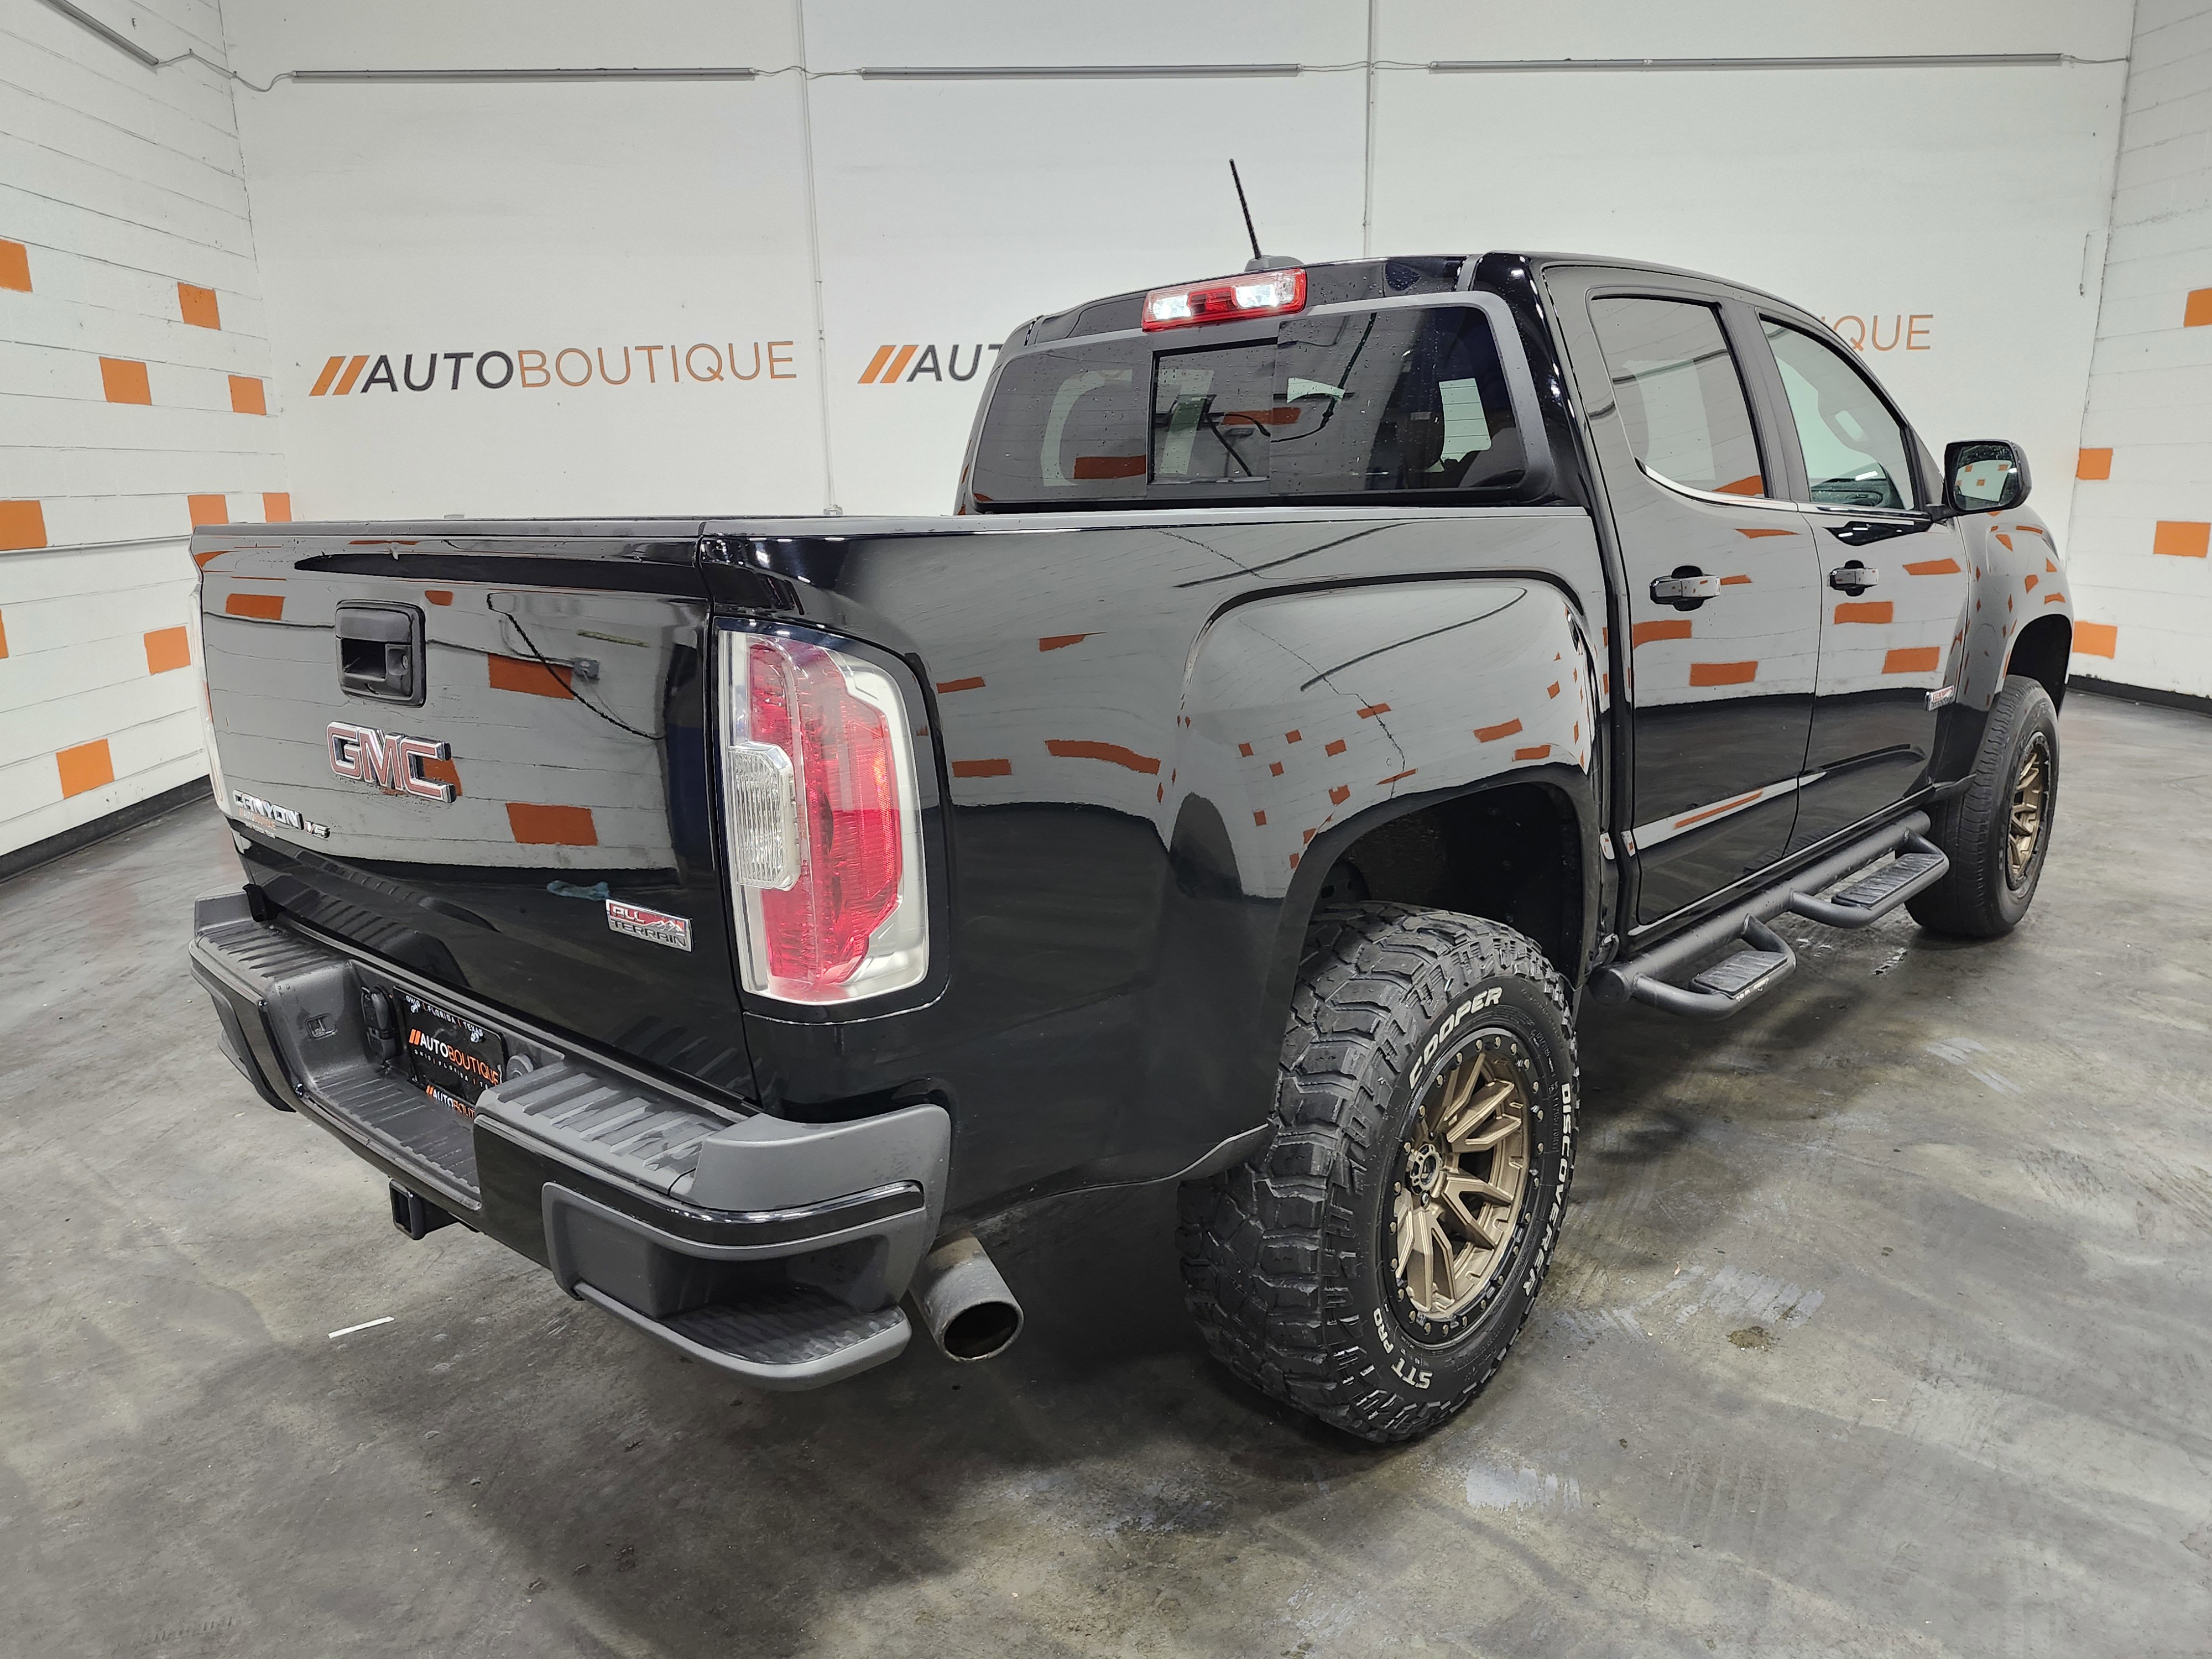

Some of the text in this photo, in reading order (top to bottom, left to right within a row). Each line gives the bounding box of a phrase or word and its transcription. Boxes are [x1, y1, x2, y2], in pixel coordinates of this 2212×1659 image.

[1822, 314, 1933, 351] QUE
[360, 341, 796, 393] AUTOBOUTIQUE
[327, 721, 456, 802] GMC
[232, 789, 304, 830] CANYON
[611, 920, 686, 947] TERRAIN
[612, 905, 645, 924] ALL
[405, 995, 483, 1037] OHIO FLORIDA TEXAS
[1410, 987, 1503, 1089] COOPER
[420, 1033, 499, 1087] AUTOBOUTIQUE
[433, 1089, 476, 1119] AUTOBOUT
[1522, 1082, 1572, 1296] DISCOVERER
[1374, 1308, 1394, 1354] PRO
[1391, 1358, 1433, 1389] STT
